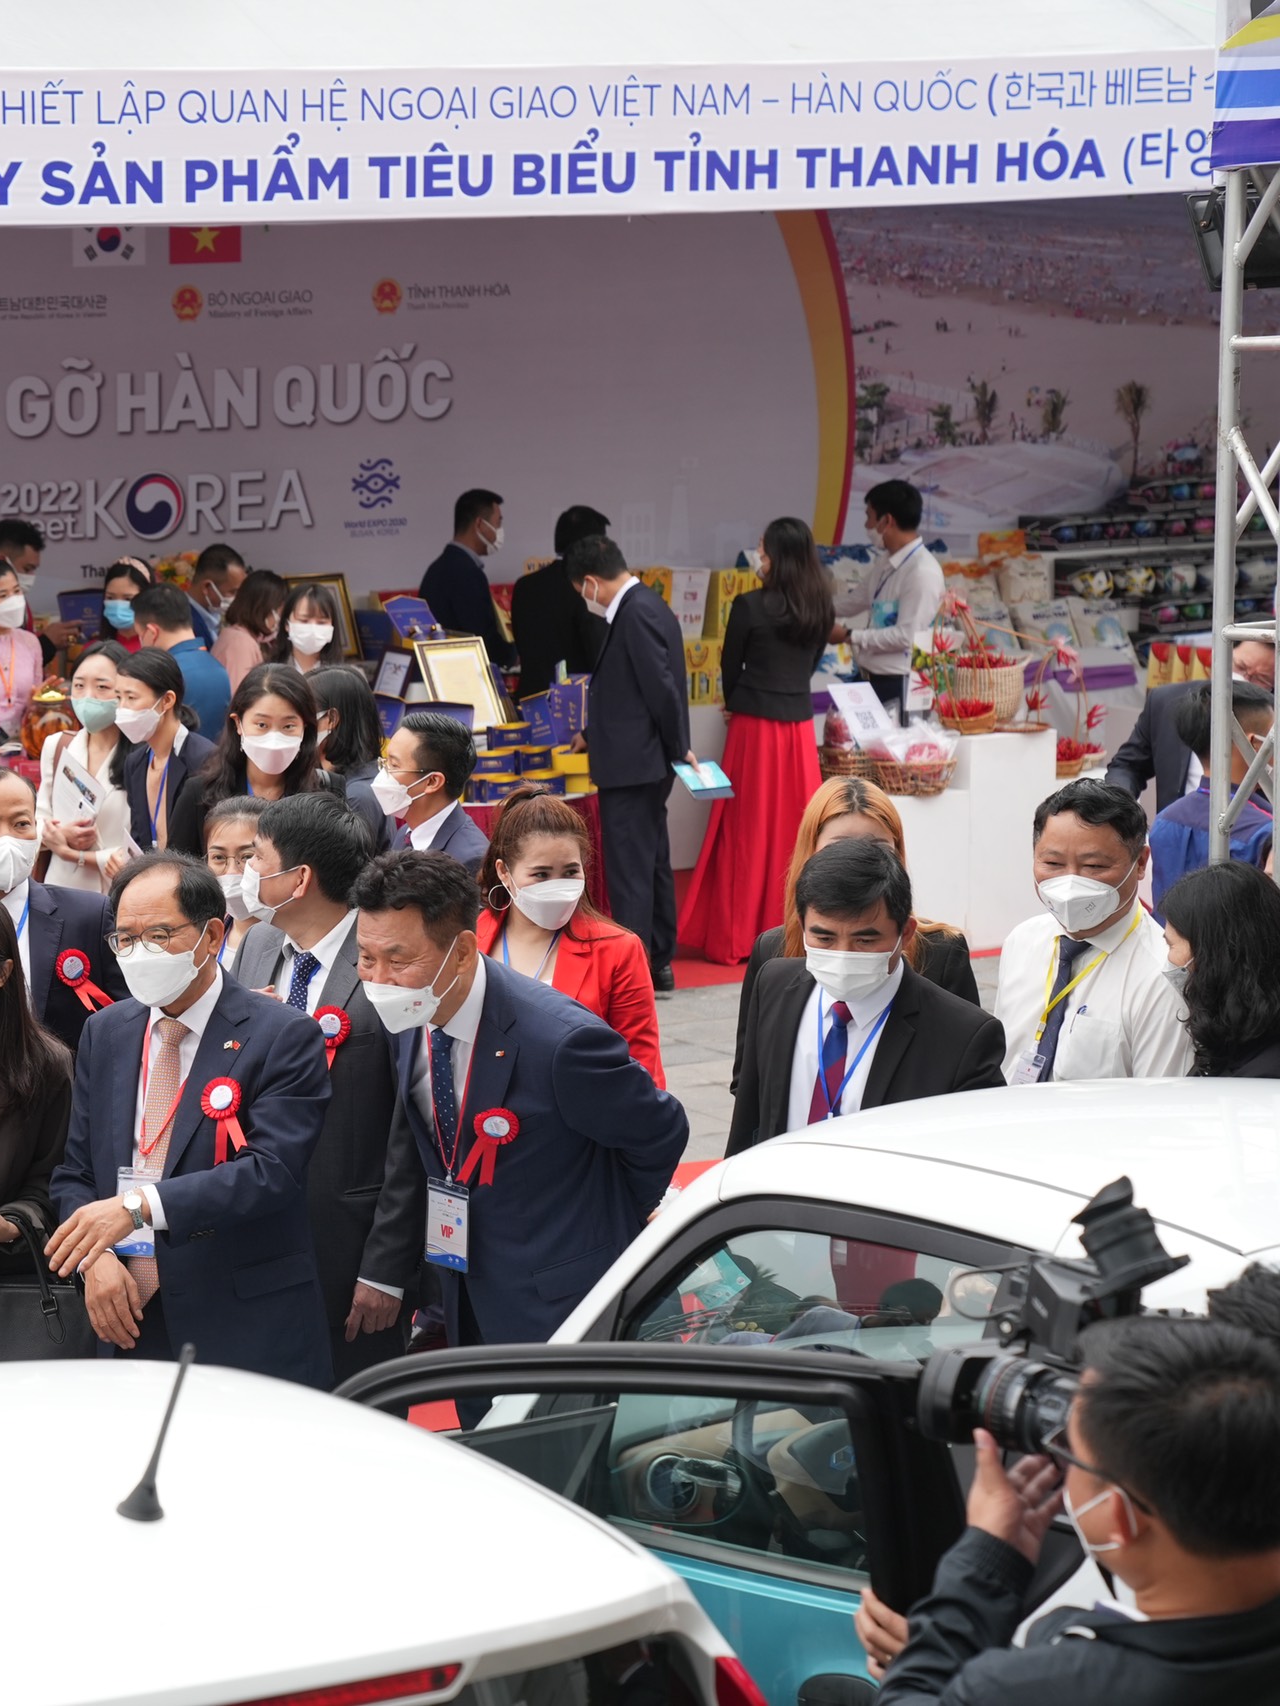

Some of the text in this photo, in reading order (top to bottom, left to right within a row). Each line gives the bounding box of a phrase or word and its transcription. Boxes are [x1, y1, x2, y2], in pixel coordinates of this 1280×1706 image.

[96, 80, 166, 135] LẬP
[177, 87, 289, 124] QUAN
[302, 78, 349, 132] HỆ
[359, 85, 478, 130] NGOẠI
[487, 83, 578, 120] GIAO
[587, 74, 662, 126] VIỆT
[673, 83, 751, 116] NAM
[791, 72, 863, 115] HÀN
[872, 68, 979, 113] QUỐC
[1105, 64, 1198, 107] 베트남
[39, 141, 164, 205] SẢN
[184, 132, 351, 203] PHẨM
[368, 142, 494, 198] TIÊU
[512, 127, 637, 196] BIỂU
[654, 131, 779, 193] TỈNH
[796, 144, 980, 189] THANH
[995, 127, 1107, 183] HÓA
[207, 288, 313, 308] BỘ NGOẠI GIAO
[437, 284, 481, 298] THANH
[5, 356, 106, 439] GỠ
[116, 351, 260, 434] HÀN
[272, 342, 454, 429] QUỐC
[0, 481, 82, 516] 2022
[440, 1223, 454, 1239] VIP
